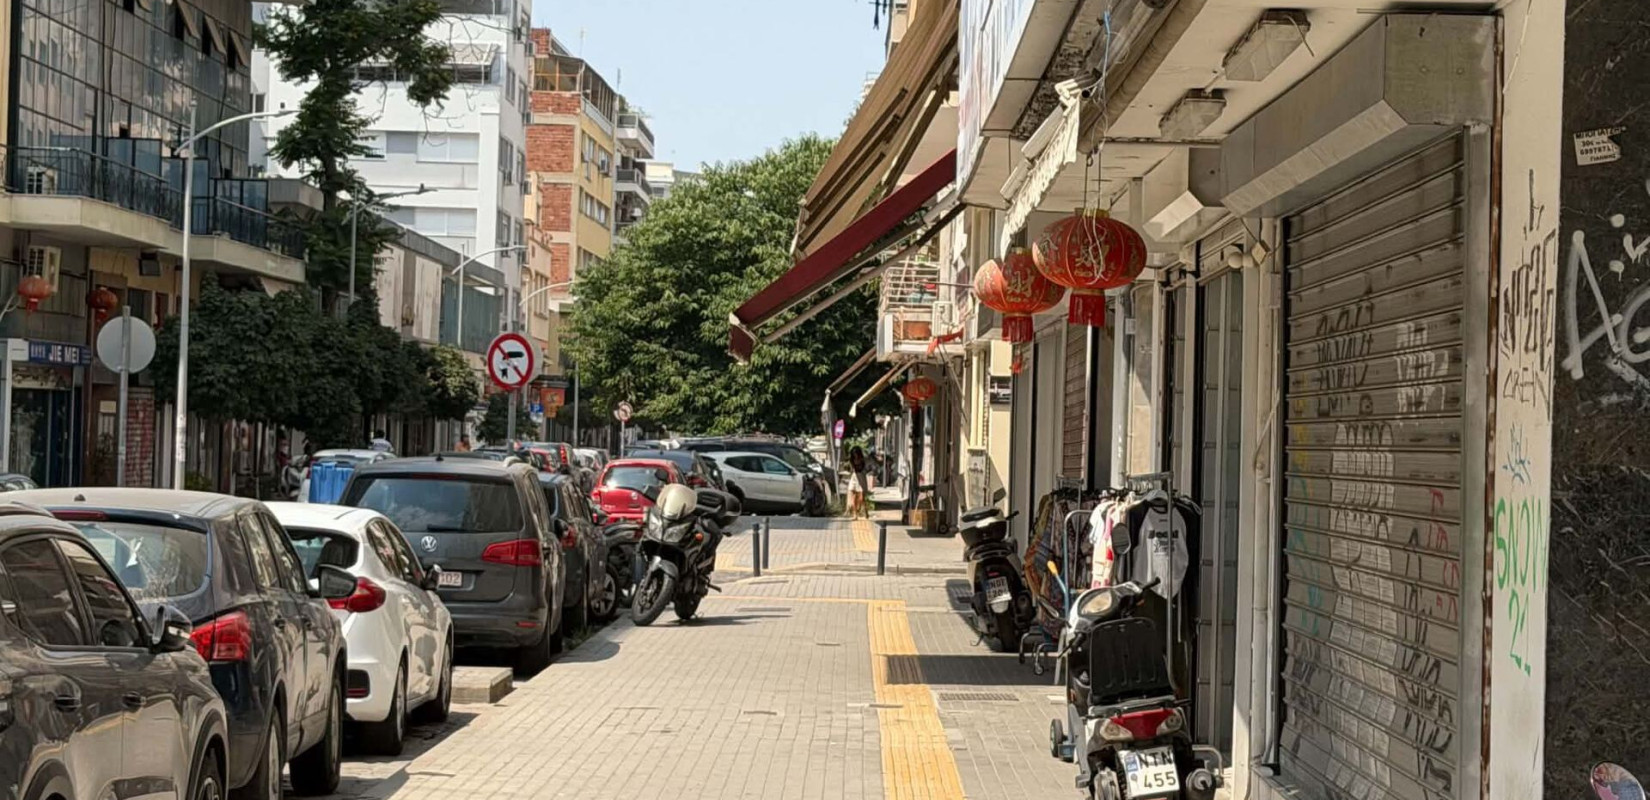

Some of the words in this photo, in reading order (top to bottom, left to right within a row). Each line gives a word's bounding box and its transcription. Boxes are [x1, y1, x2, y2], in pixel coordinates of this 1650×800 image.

[49, 344, 62, 362] JIE
[64, 346, 80, 363] MEI
[1135, 746, 1175, 769] NTN
[1143, 771, 1177, 788] 455
